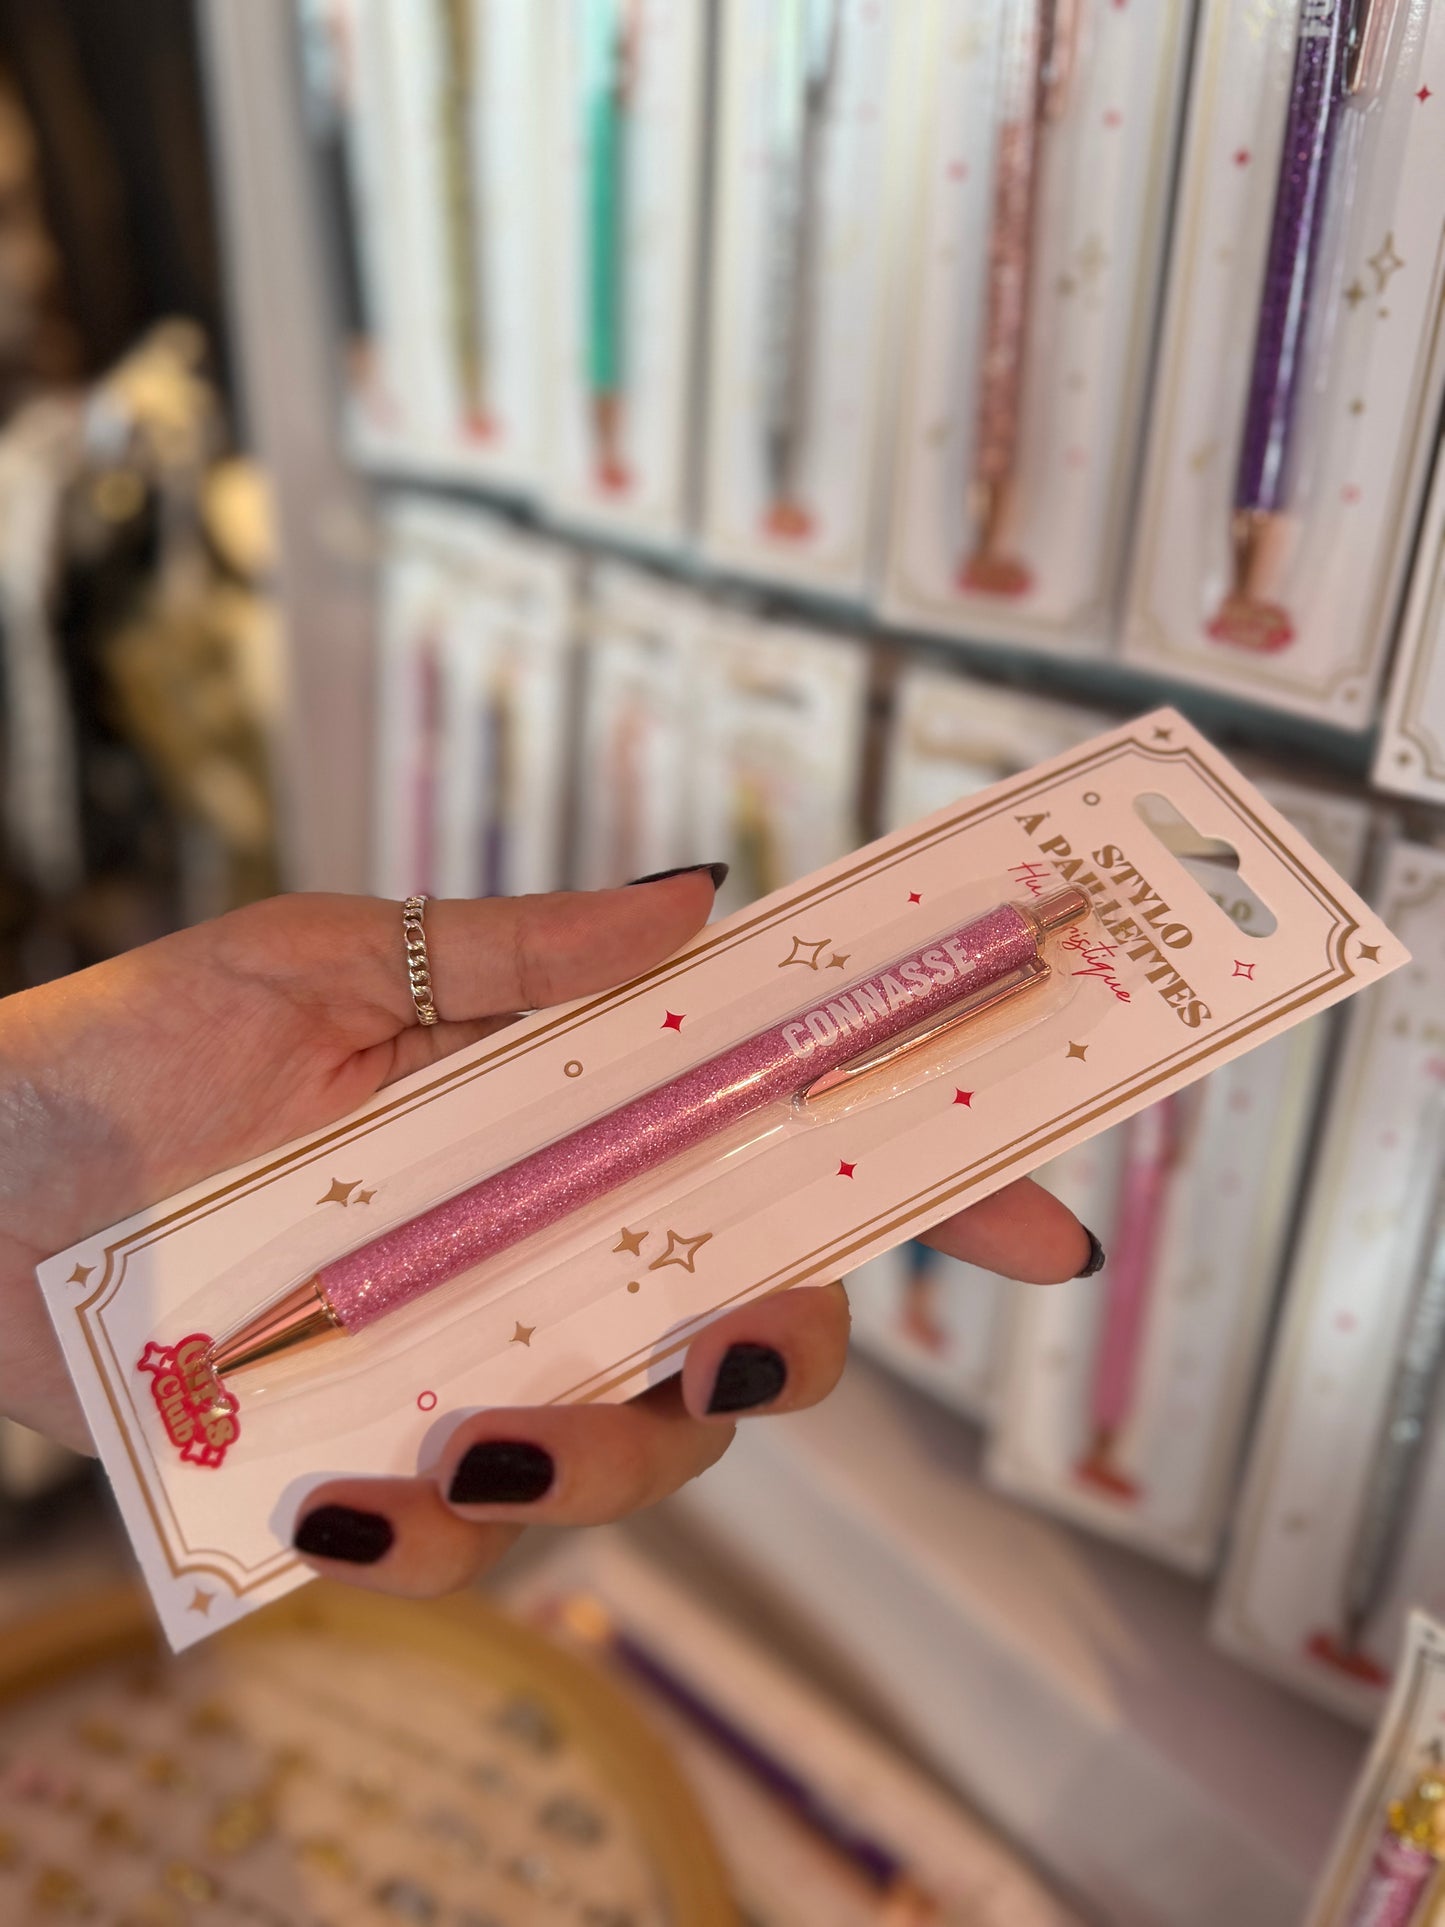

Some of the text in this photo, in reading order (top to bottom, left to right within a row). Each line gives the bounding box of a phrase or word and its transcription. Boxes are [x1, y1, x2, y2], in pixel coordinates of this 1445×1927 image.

[1092, 844, 1193, 949] STYLO
[781, 937, 977, 1059] CONNASSE
[157, 1374, 195, 1443] Club
